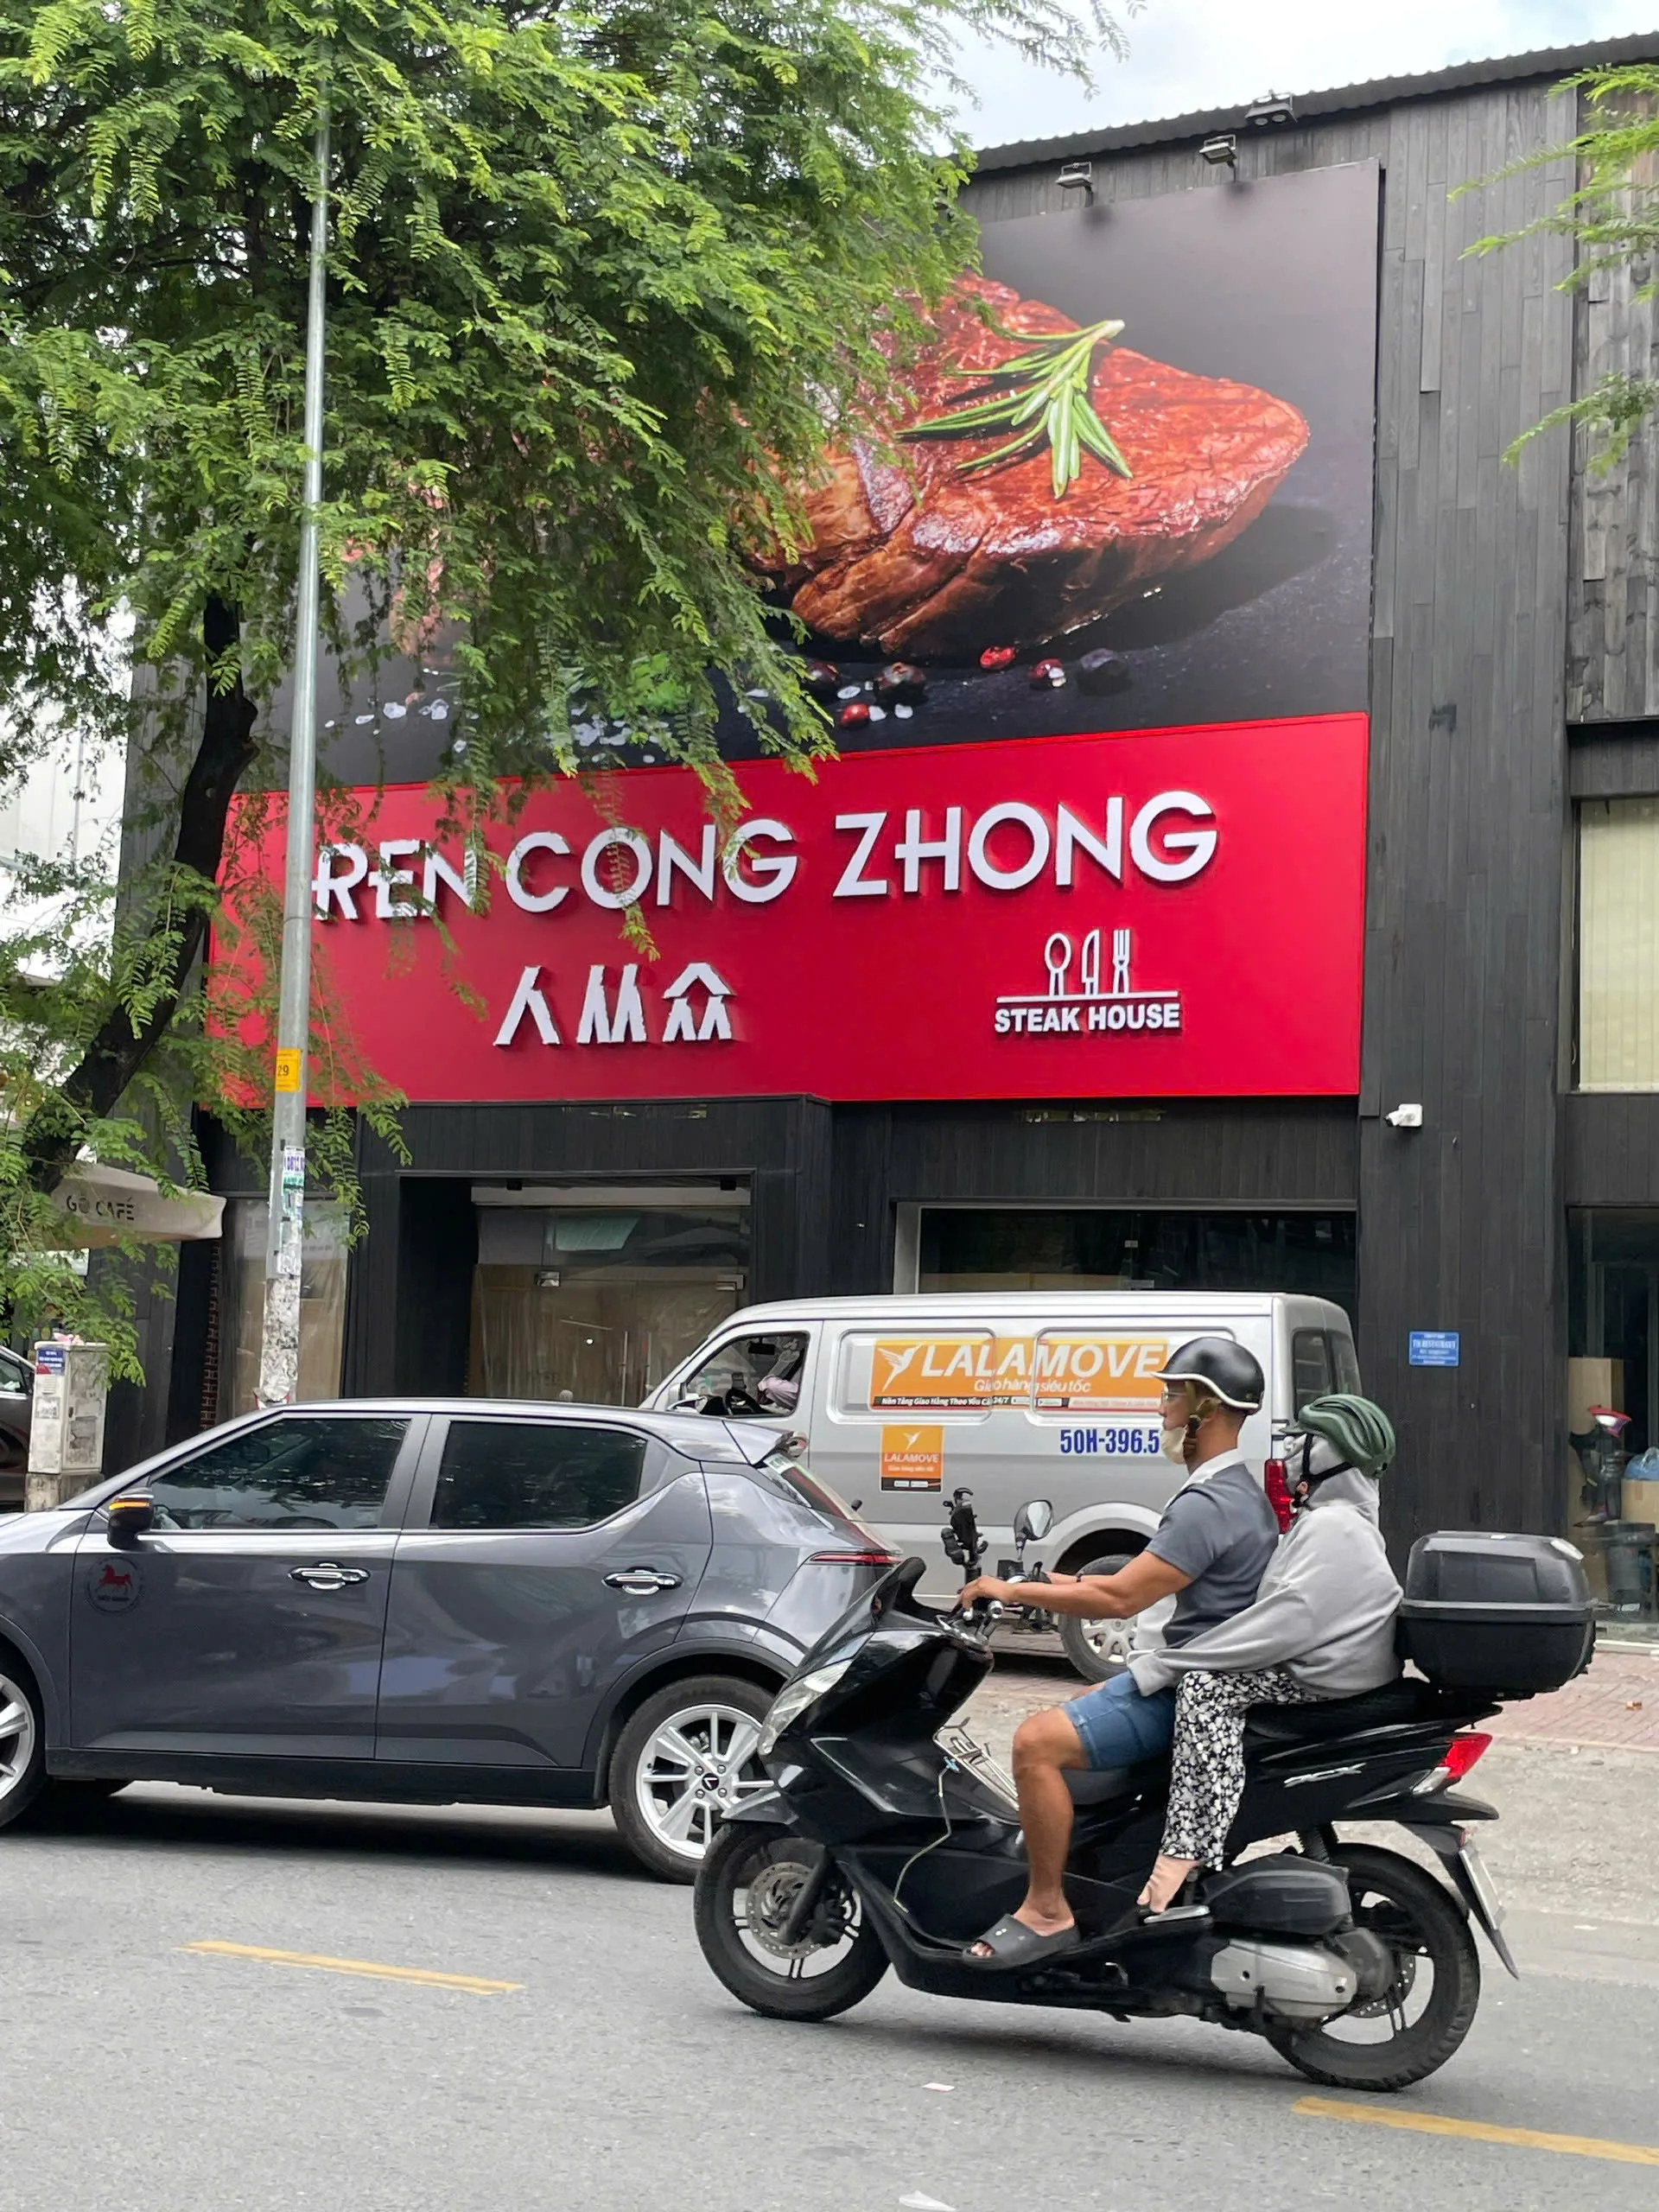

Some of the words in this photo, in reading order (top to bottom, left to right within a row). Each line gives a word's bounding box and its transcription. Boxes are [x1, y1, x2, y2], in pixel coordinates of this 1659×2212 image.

[311, 839, 481, 921] REN
[505, 818, 798, 913] CONG
[832, 790, 1217, 898] ZHONG
[994, 1007, 1080, 1033] STEAK
[1088, 1002, 1180, 1031] HOUSE
[66, 1195, 91, 1214] GO
[95, 1196, 135, 1221] CAFÉ
[920, 1342, 1165, 1378] LALAMOVE
[1059, 1428, 1160, 1453] 50H-396.5
[884, 1452, 940, 1463] LALAMOVE
